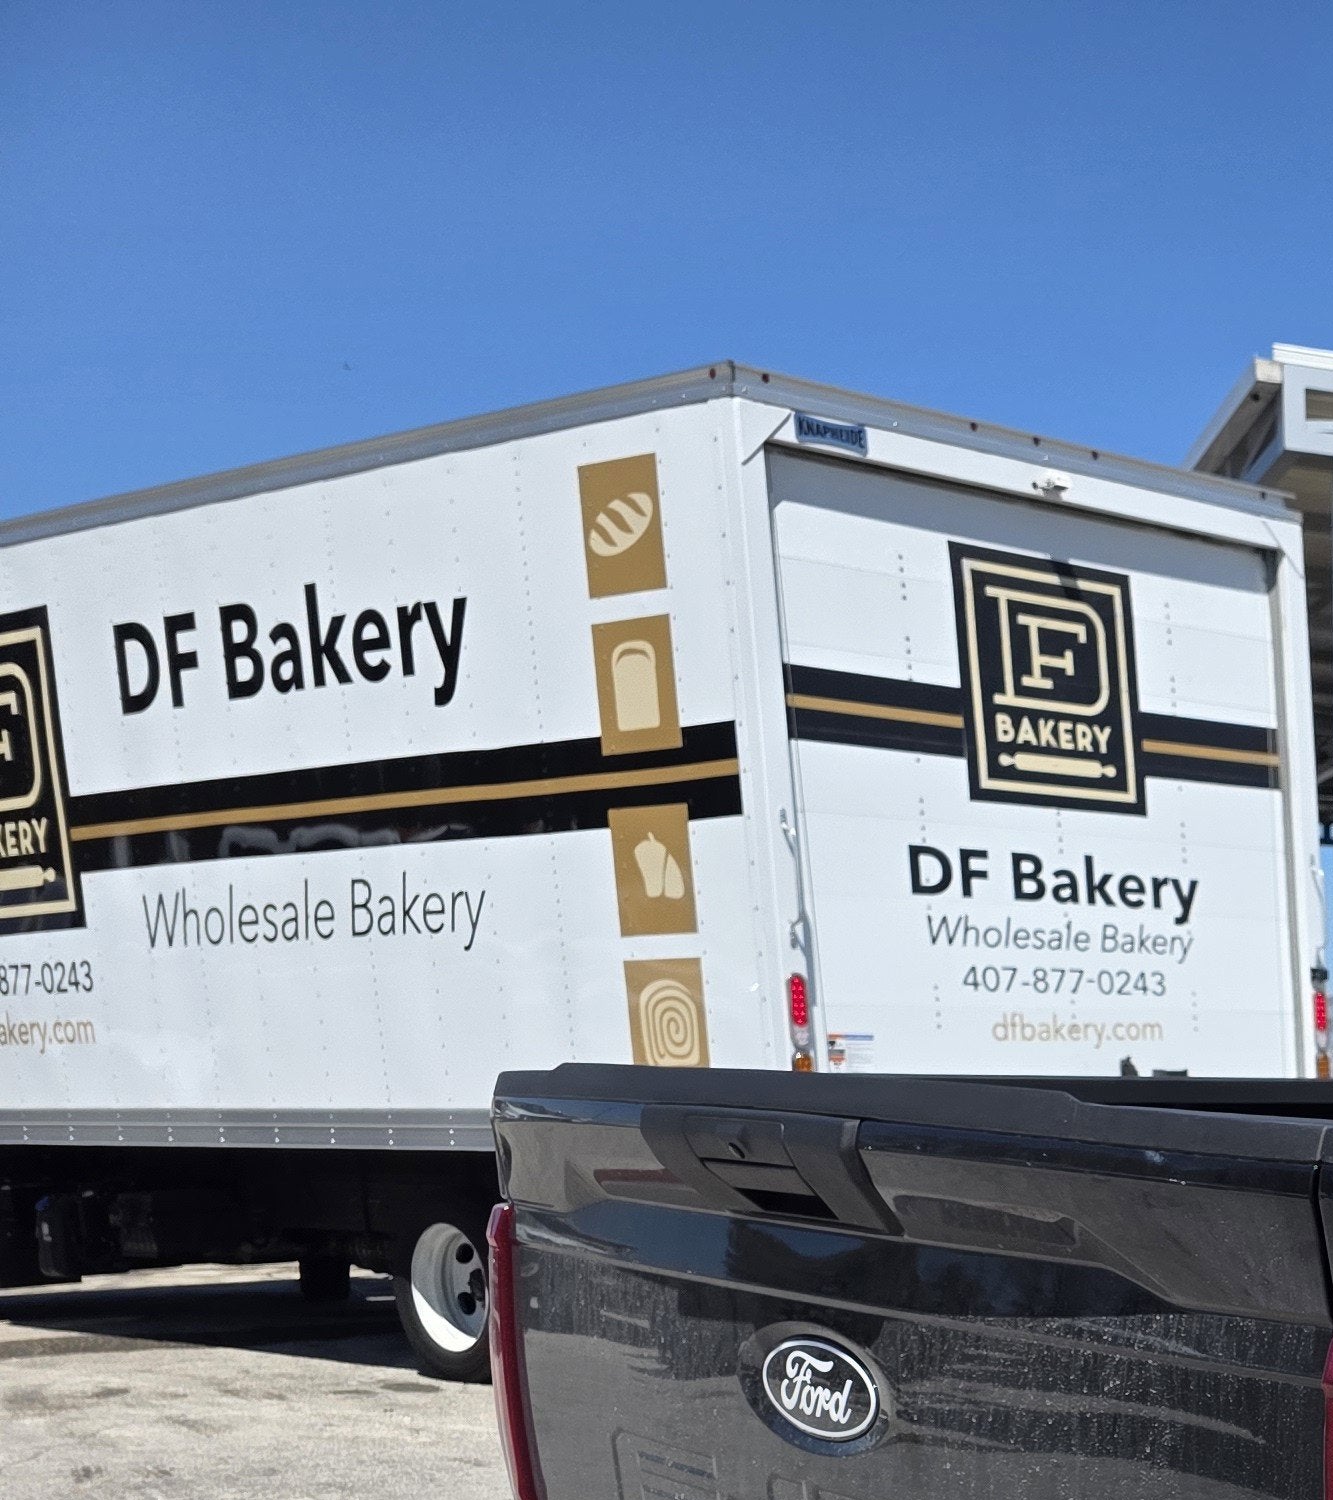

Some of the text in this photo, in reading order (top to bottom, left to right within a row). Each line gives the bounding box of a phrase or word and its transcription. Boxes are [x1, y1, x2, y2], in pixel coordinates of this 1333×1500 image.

[112, 582, 468, 716] DF Bakery
[994, 714, 1112, 754] BAKERY
[142, 871, 486, 951] Wholesale Bakery
[907, 844, 1200, 925] DF Bakery
[926, 915, 1195, 964] Wholesale Bakery
[962, 966, 1168, 997] 407-877-0243
[992, 1013, 1164, 1049] dfbakery.com
[780, 1350, 854, 1425] Ford
